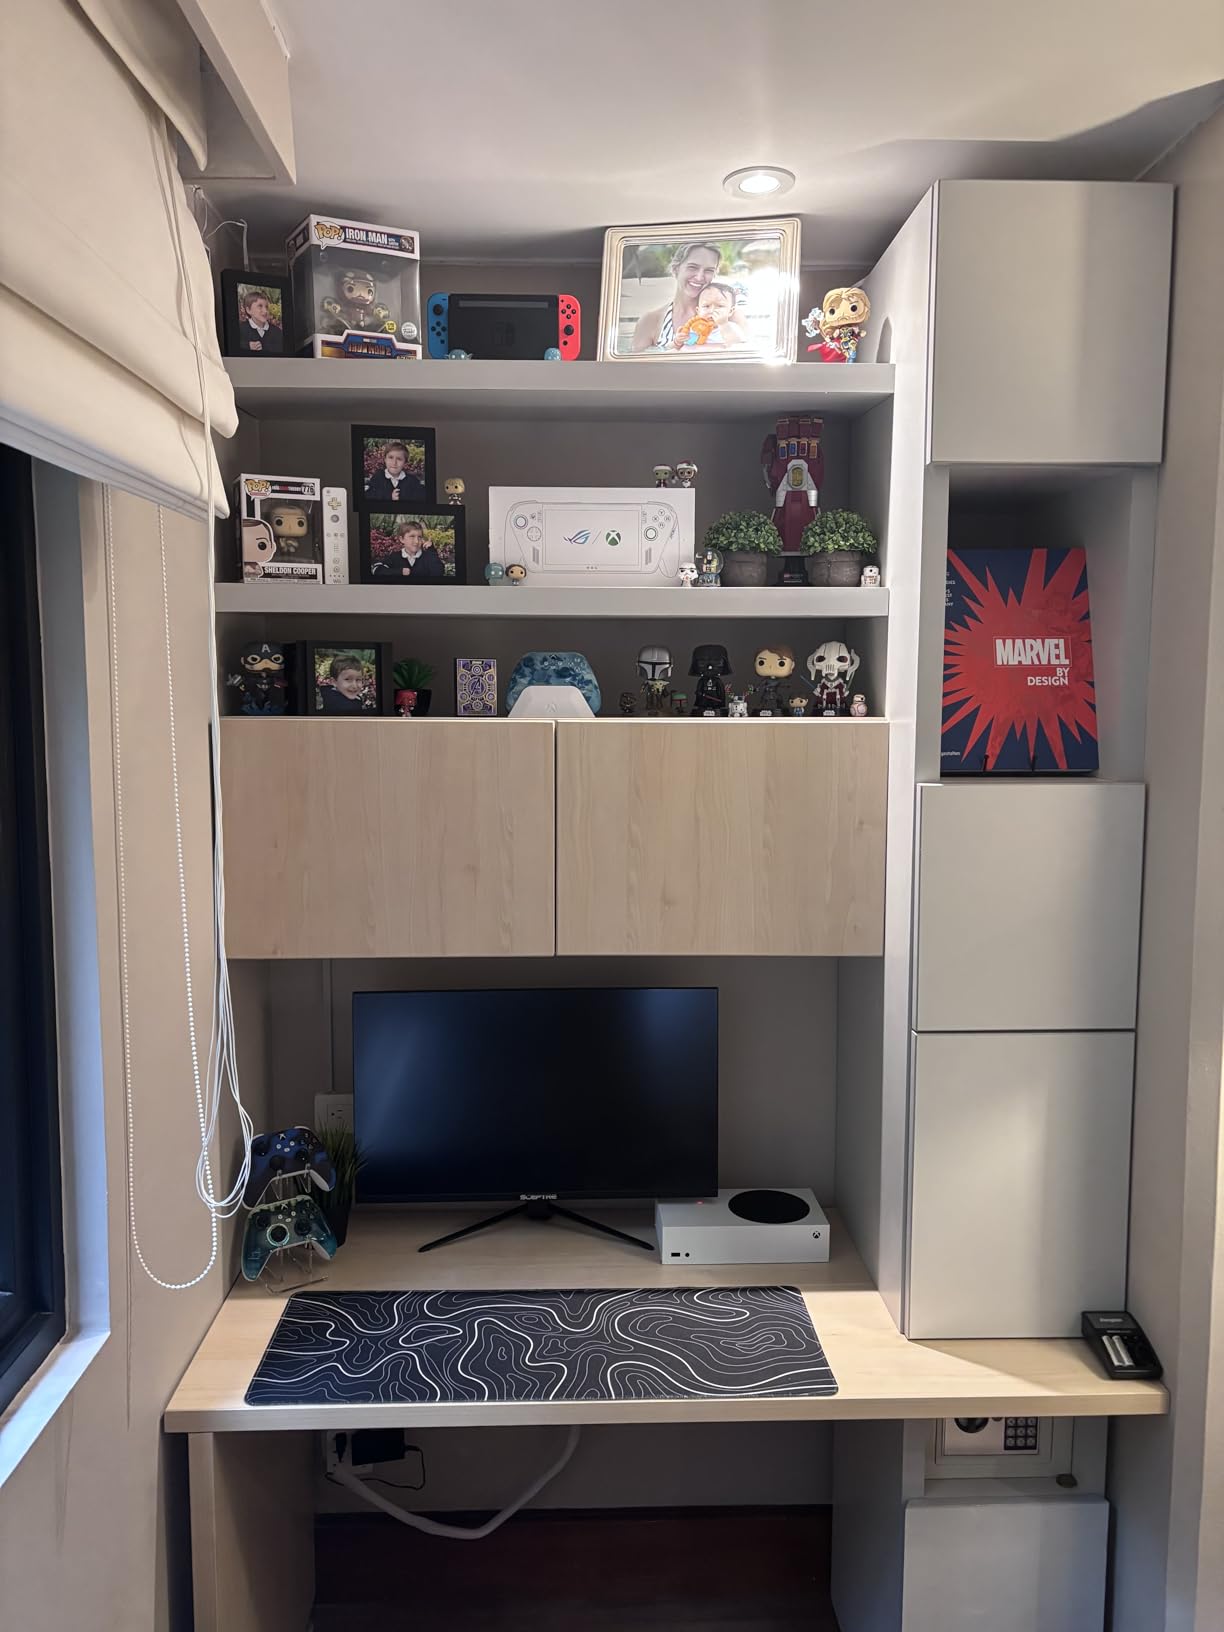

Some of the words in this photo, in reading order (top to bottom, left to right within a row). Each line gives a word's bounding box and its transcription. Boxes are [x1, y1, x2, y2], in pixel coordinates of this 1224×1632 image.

[314, 223, 343, 240] POP!
[345, 228, 366, 242] IRON
[368, 233, 388, 245] MAN
[244, 480, 271, 492] POP!
[264, 566, 292, 574] SHELDON
[261, 643, 271, 653] A
[995, 638, 1070, 666] MARVEL
[1056, 667, 1070, 677] BY
[1027, 676, 1069, 686] DESIGN
